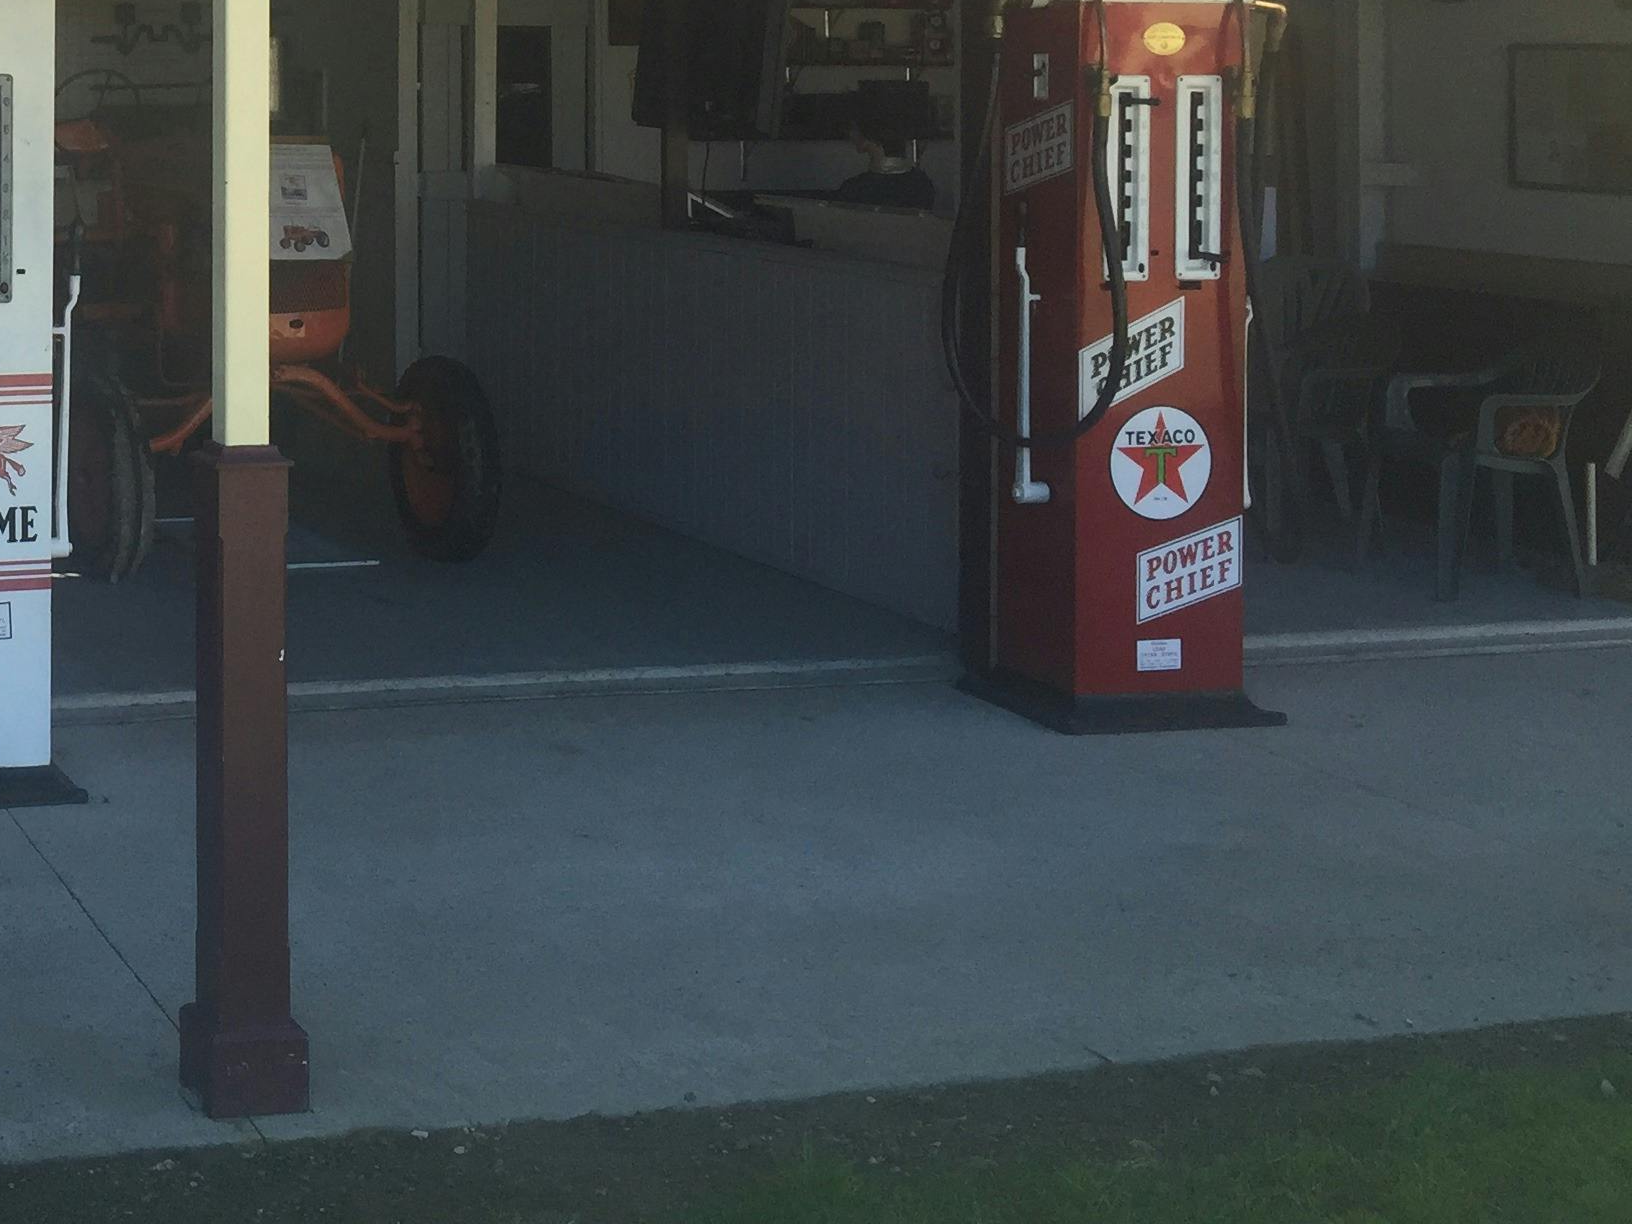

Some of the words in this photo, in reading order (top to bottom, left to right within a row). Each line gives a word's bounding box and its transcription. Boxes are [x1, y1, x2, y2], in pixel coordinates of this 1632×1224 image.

[1010, 113, 1067, 155] POWER
[1010, 141, 1067, 184] CHIEF
[1090, 316, 1175, 380] PWER
[1125, 429, 1196, 446] TEXACO
[1145, 530, 1234, 582] POWER
[1145, 558, 1233, 610] CHIEF
